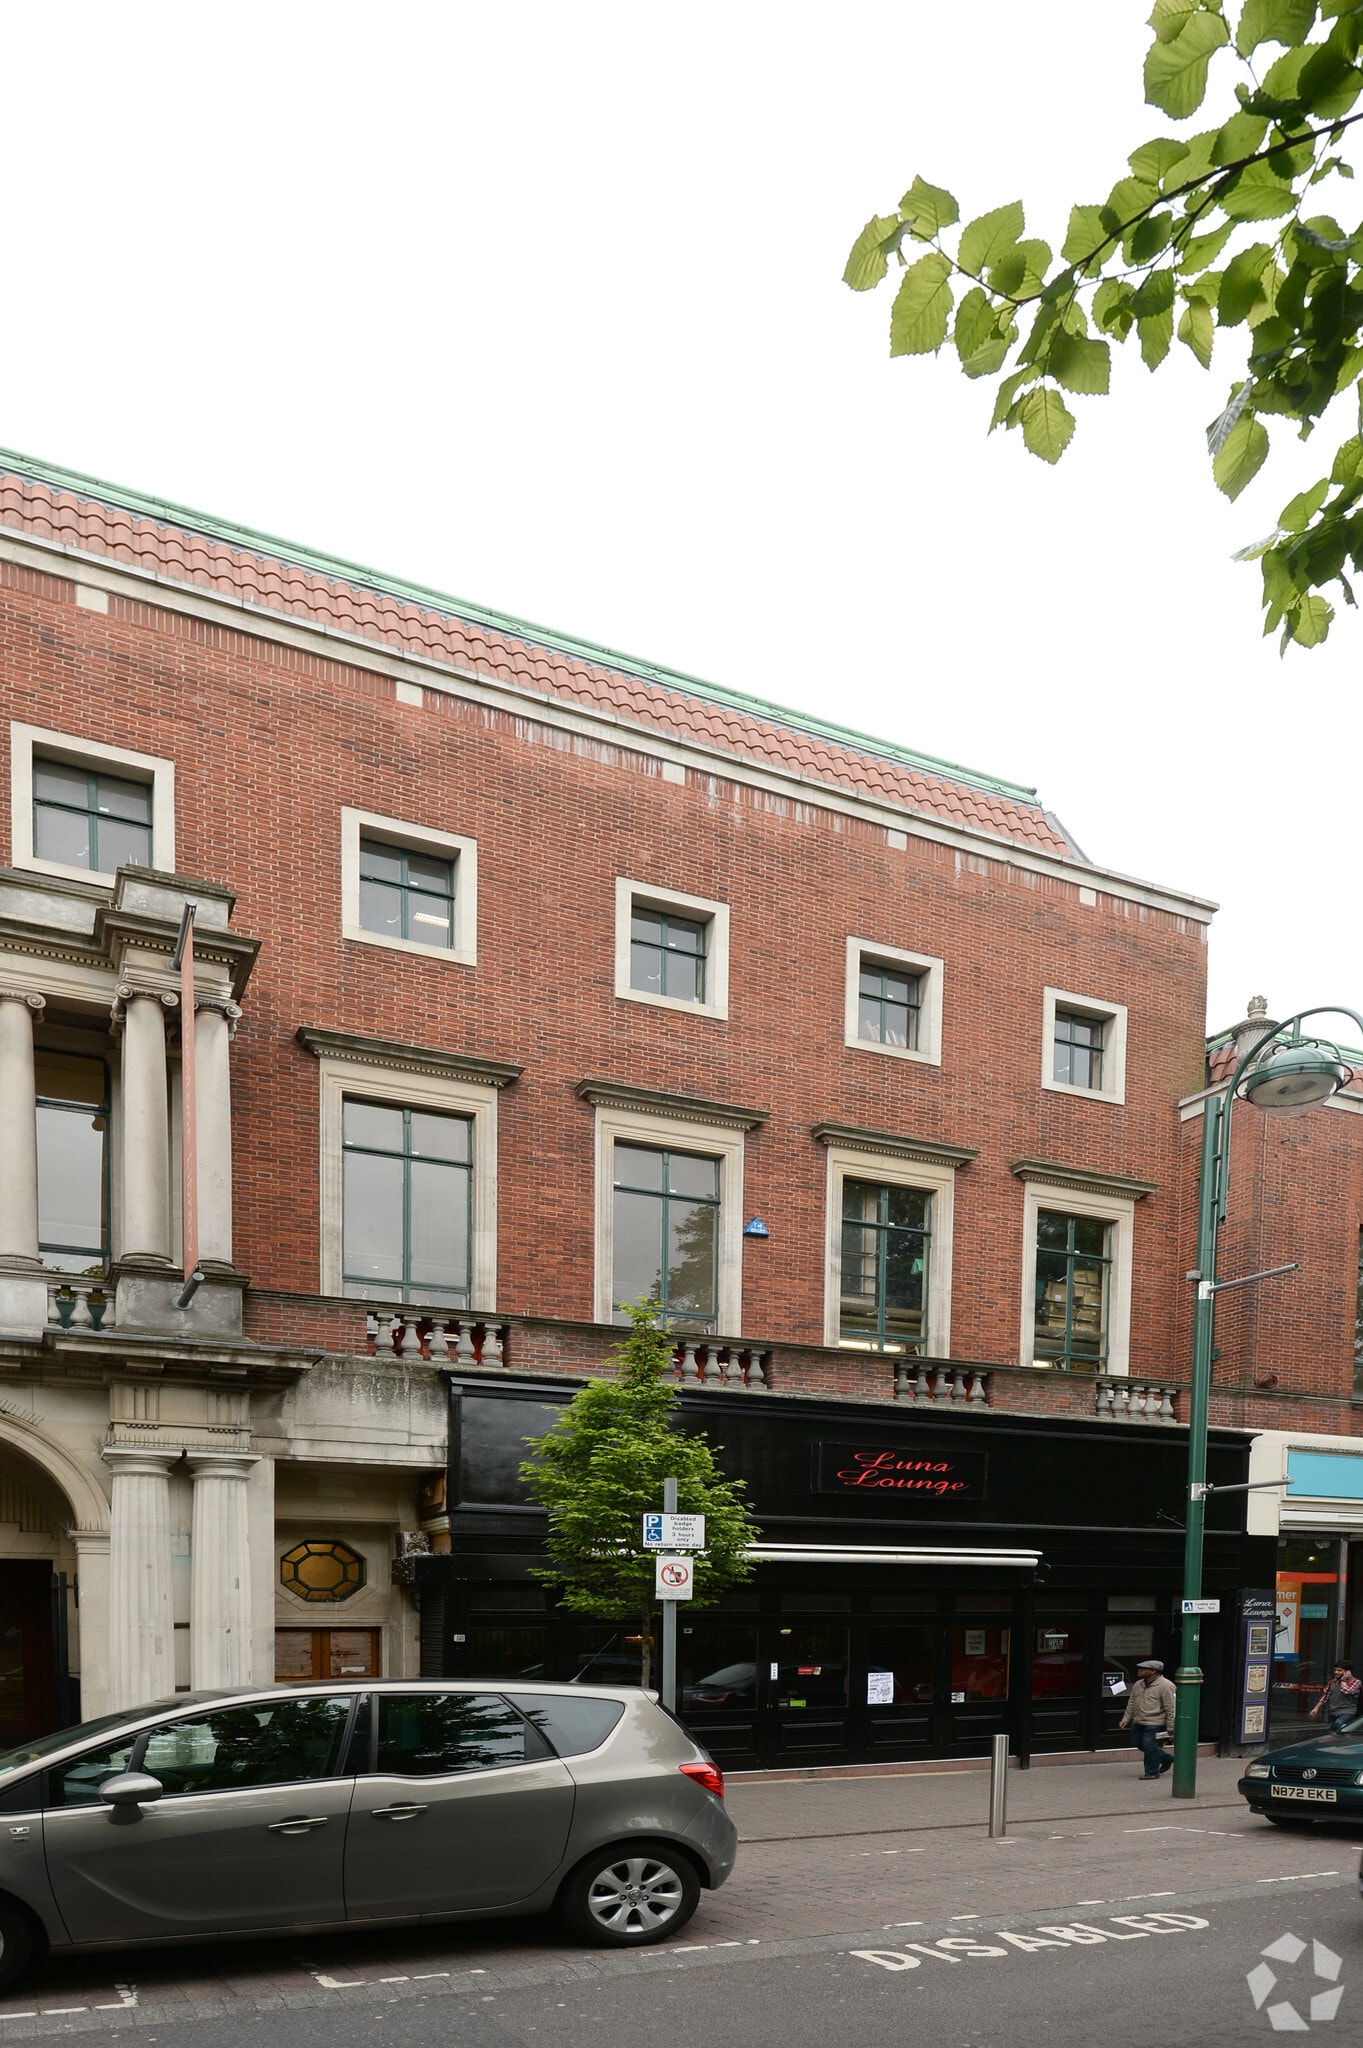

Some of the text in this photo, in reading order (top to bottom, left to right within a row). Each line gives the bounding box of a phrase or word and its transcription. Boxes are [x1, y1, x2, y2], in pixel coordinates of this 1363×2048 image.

[854, 1452, 954, 1472] Luna
[836, 1469, 970, 1496] Lounge
[648, 1516, 659, 1527] P
[1243, 1598, 1273, 1607] Luna
[1242, 1607, 1275, 1618] Lounge
[1272, 1786, 1335, 1800] N872 EKE
[848, 1913, 1210, 1971] DISABLED
